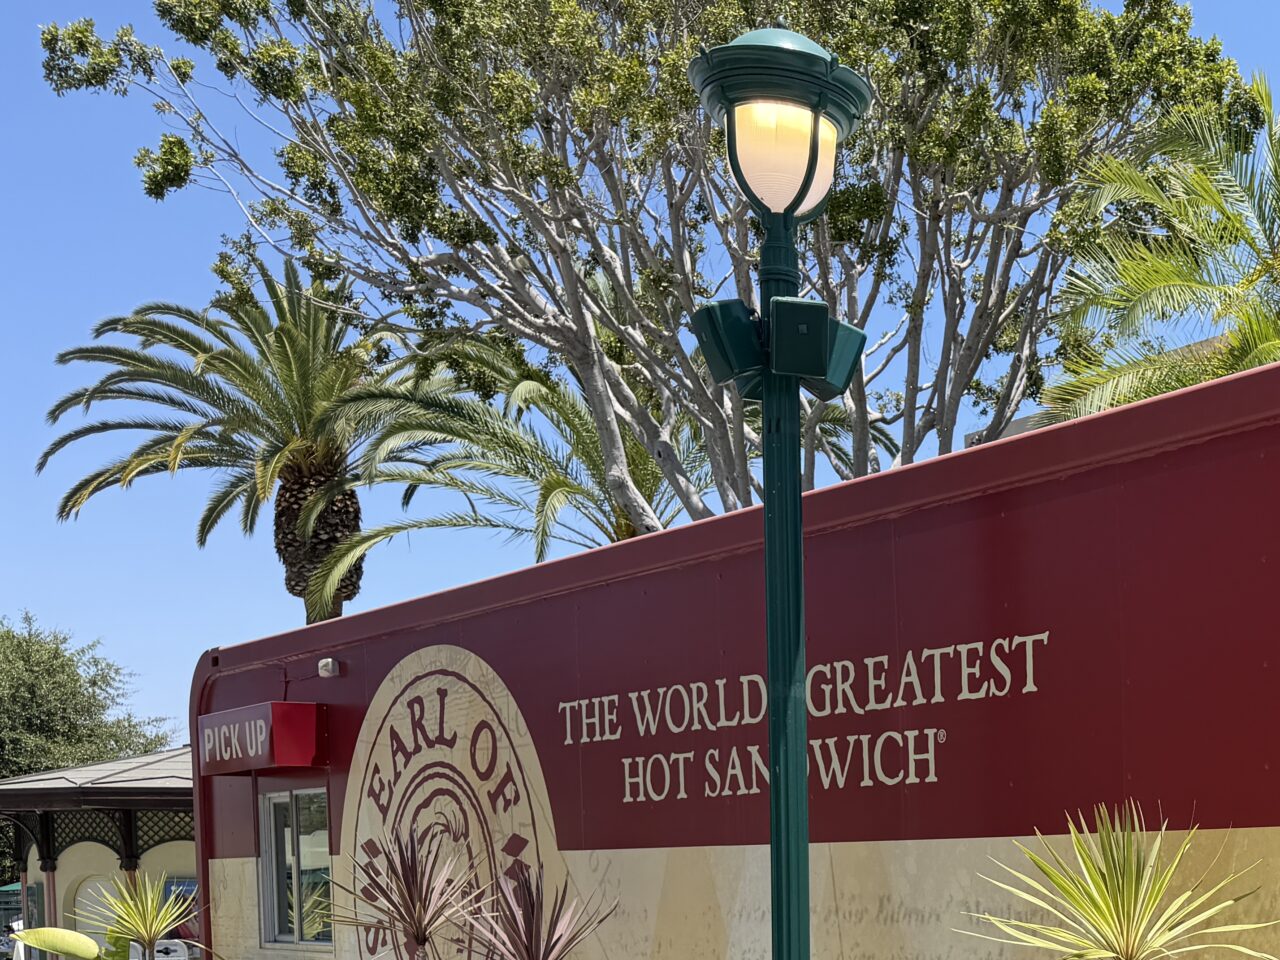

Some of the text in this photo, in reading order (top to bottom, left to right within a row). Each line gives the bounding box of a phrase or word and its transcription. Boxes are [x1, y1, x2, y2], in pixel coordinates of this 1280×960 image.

[558, 631, 1050, 746] THE WORLD GREATEST
[204, 719, 267, 763] PICK UP
[368, 687, 521, 826] EARL OF
[622, 751, 694, 803] HOT
